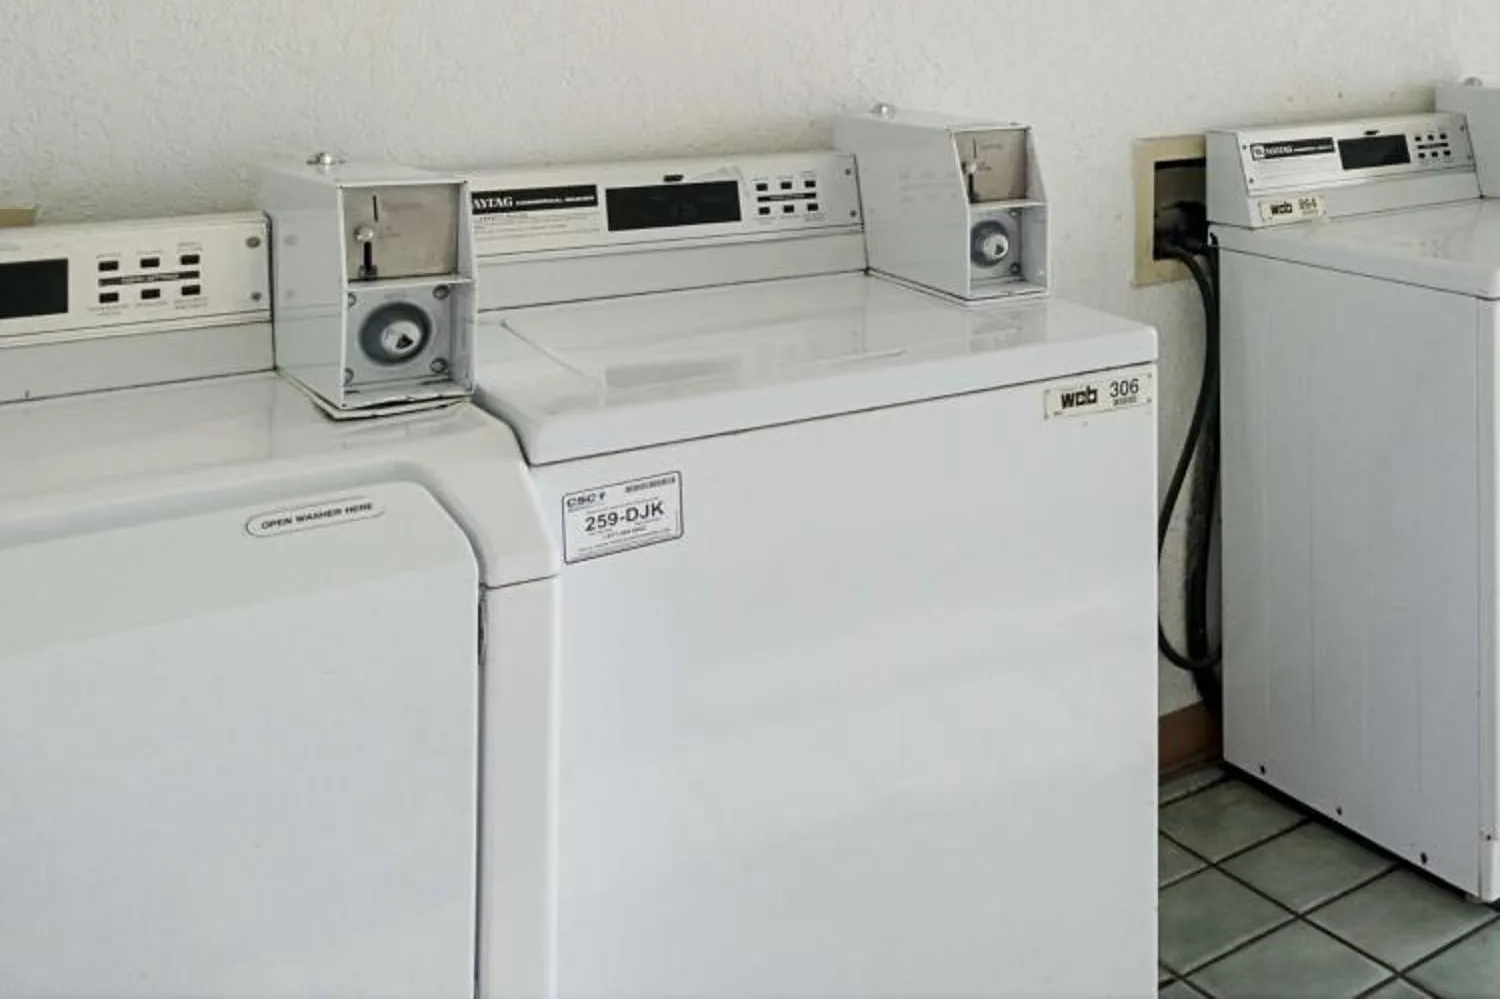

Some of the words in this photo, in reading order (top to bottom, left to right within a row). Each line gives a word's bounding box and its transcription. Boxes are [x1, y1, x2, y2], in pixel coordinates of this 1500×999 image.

[1109, 378, 1140, 399] 306
[261, 516, 293, 530] OPEN
[345, 503, 373, 514] HERE
[585, 500, 664, 533] 259-DJK
